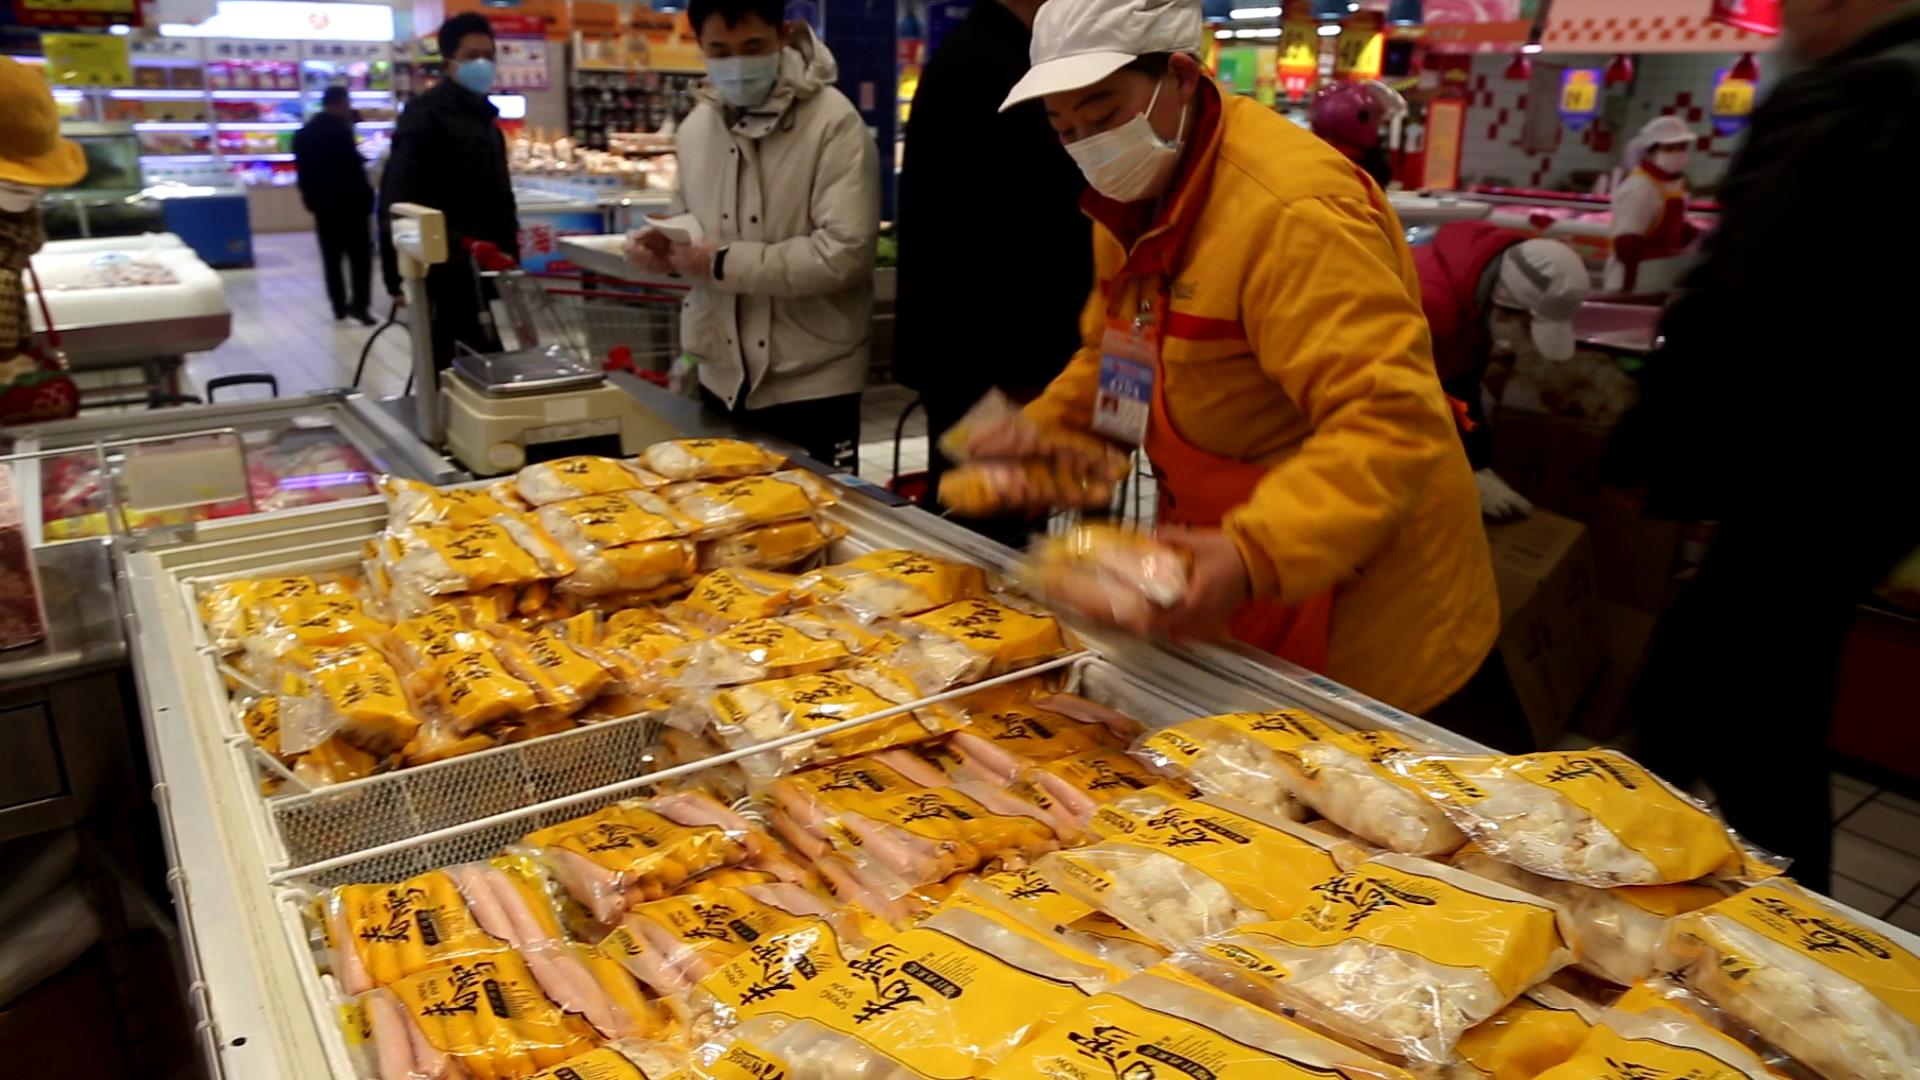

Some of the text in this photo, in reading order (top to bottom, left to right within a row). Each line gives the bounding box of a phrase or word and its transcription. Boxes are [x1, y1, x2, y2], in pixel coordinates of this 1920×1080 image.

[360, 887, 427, 944] 春雪
[420, 961, 497, 1016] 春雪
[847, 943, 925, 1025] 春雪
